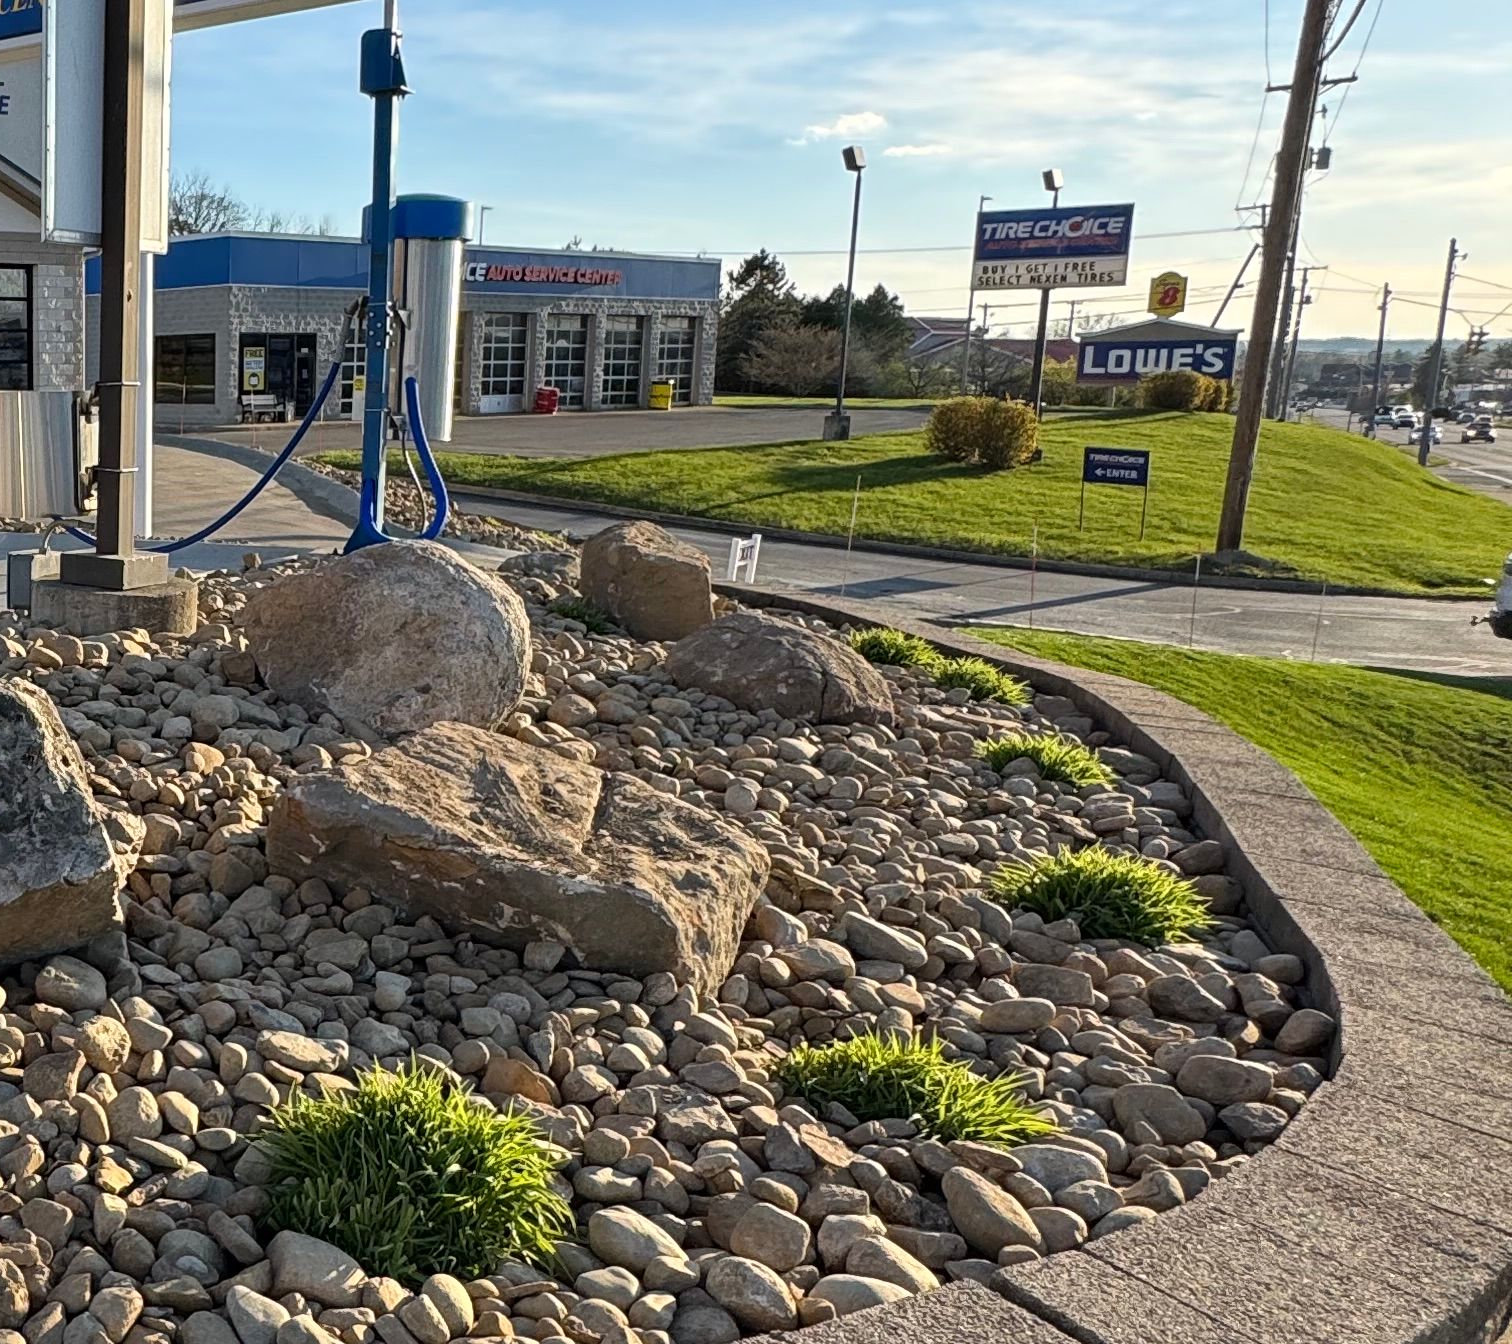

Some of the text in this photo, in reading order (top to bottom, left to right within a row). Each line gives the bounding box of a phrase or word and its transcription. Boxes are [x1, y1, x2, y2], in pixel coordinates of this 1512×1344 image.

[462, 261, 623, 285] ICE AUTO SERVICE CENTER
[982, 264, 1007, 275] BUY
[1025, 263, 1048, 274] GET
[1064, 261, 1096, 273] FREE
[977, 272, 1114, 287] SELECT NEXEN TIRES
[1157, 286, 1180, 306] 8
[245, 349, 264, 358] FREE
[1082, 343, 1226, 375] LOWE'S
[1106, 468, 1138, 479] ENTER
